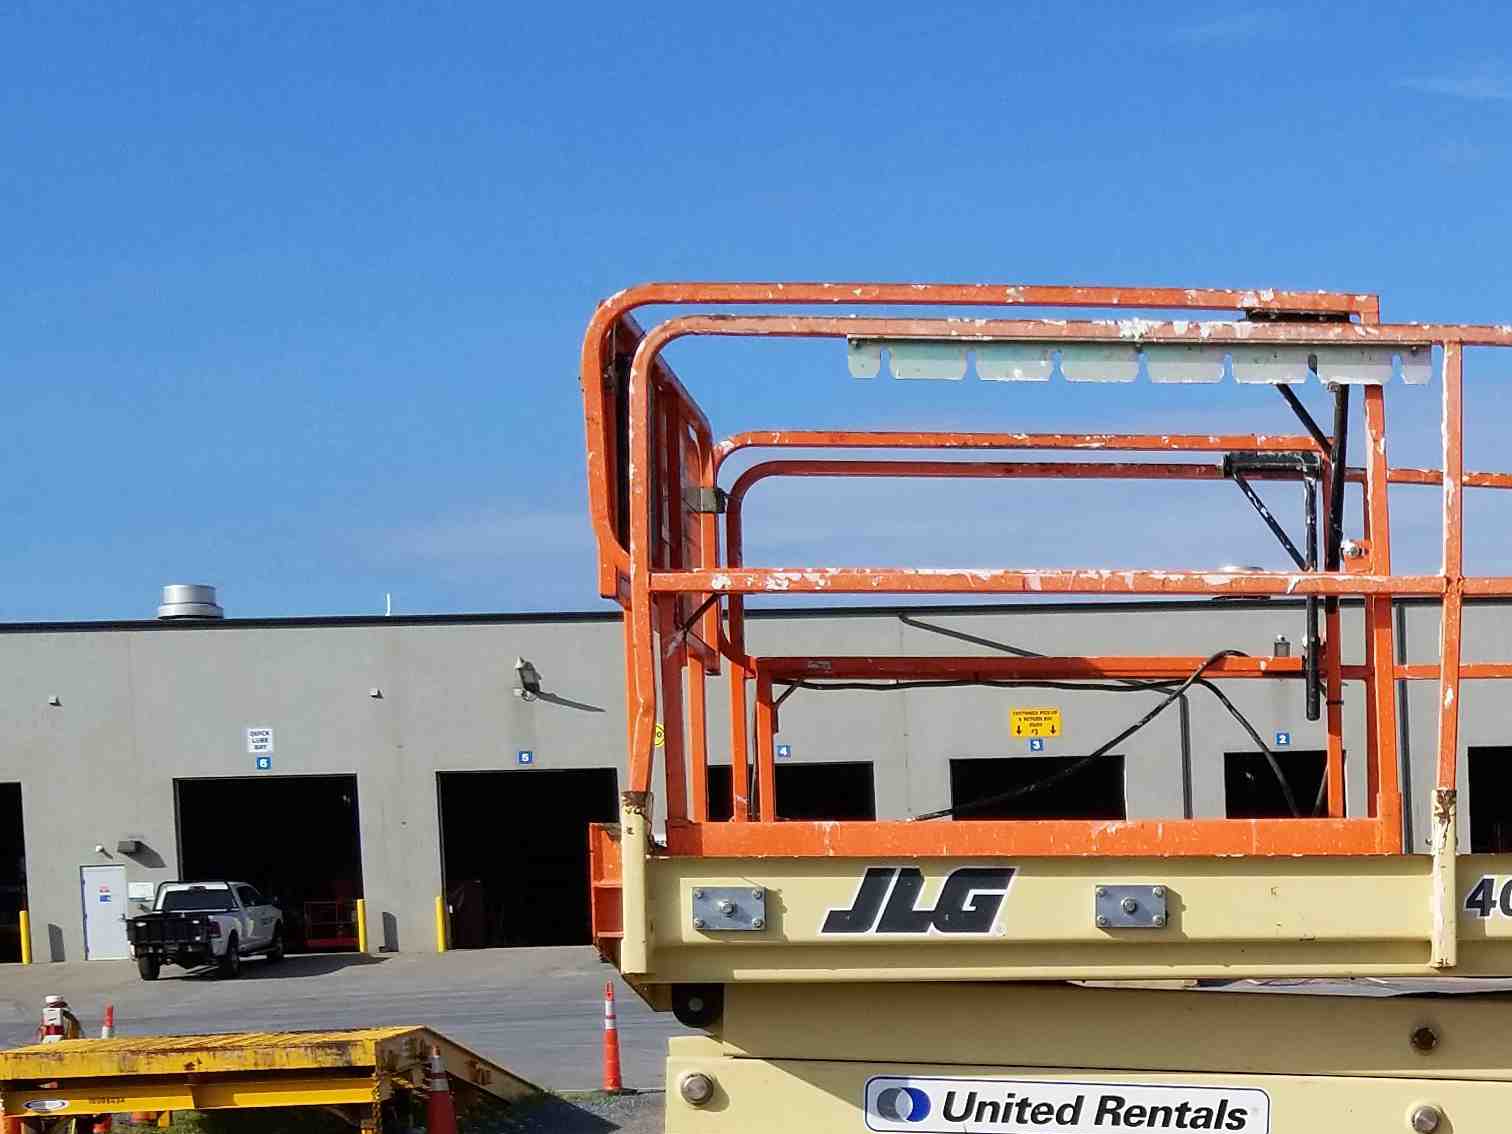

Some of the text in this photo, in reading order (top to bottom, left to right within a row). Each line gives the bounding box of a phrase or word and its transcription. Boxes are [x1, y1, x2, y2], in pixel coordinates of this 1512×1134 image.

[1031, 740, 1040, 750] 3
[259, 759, 268, 768] 6
[821, 867, 1017, 934] JLG
[942, 1091, 1249, 1131] United Rentals
